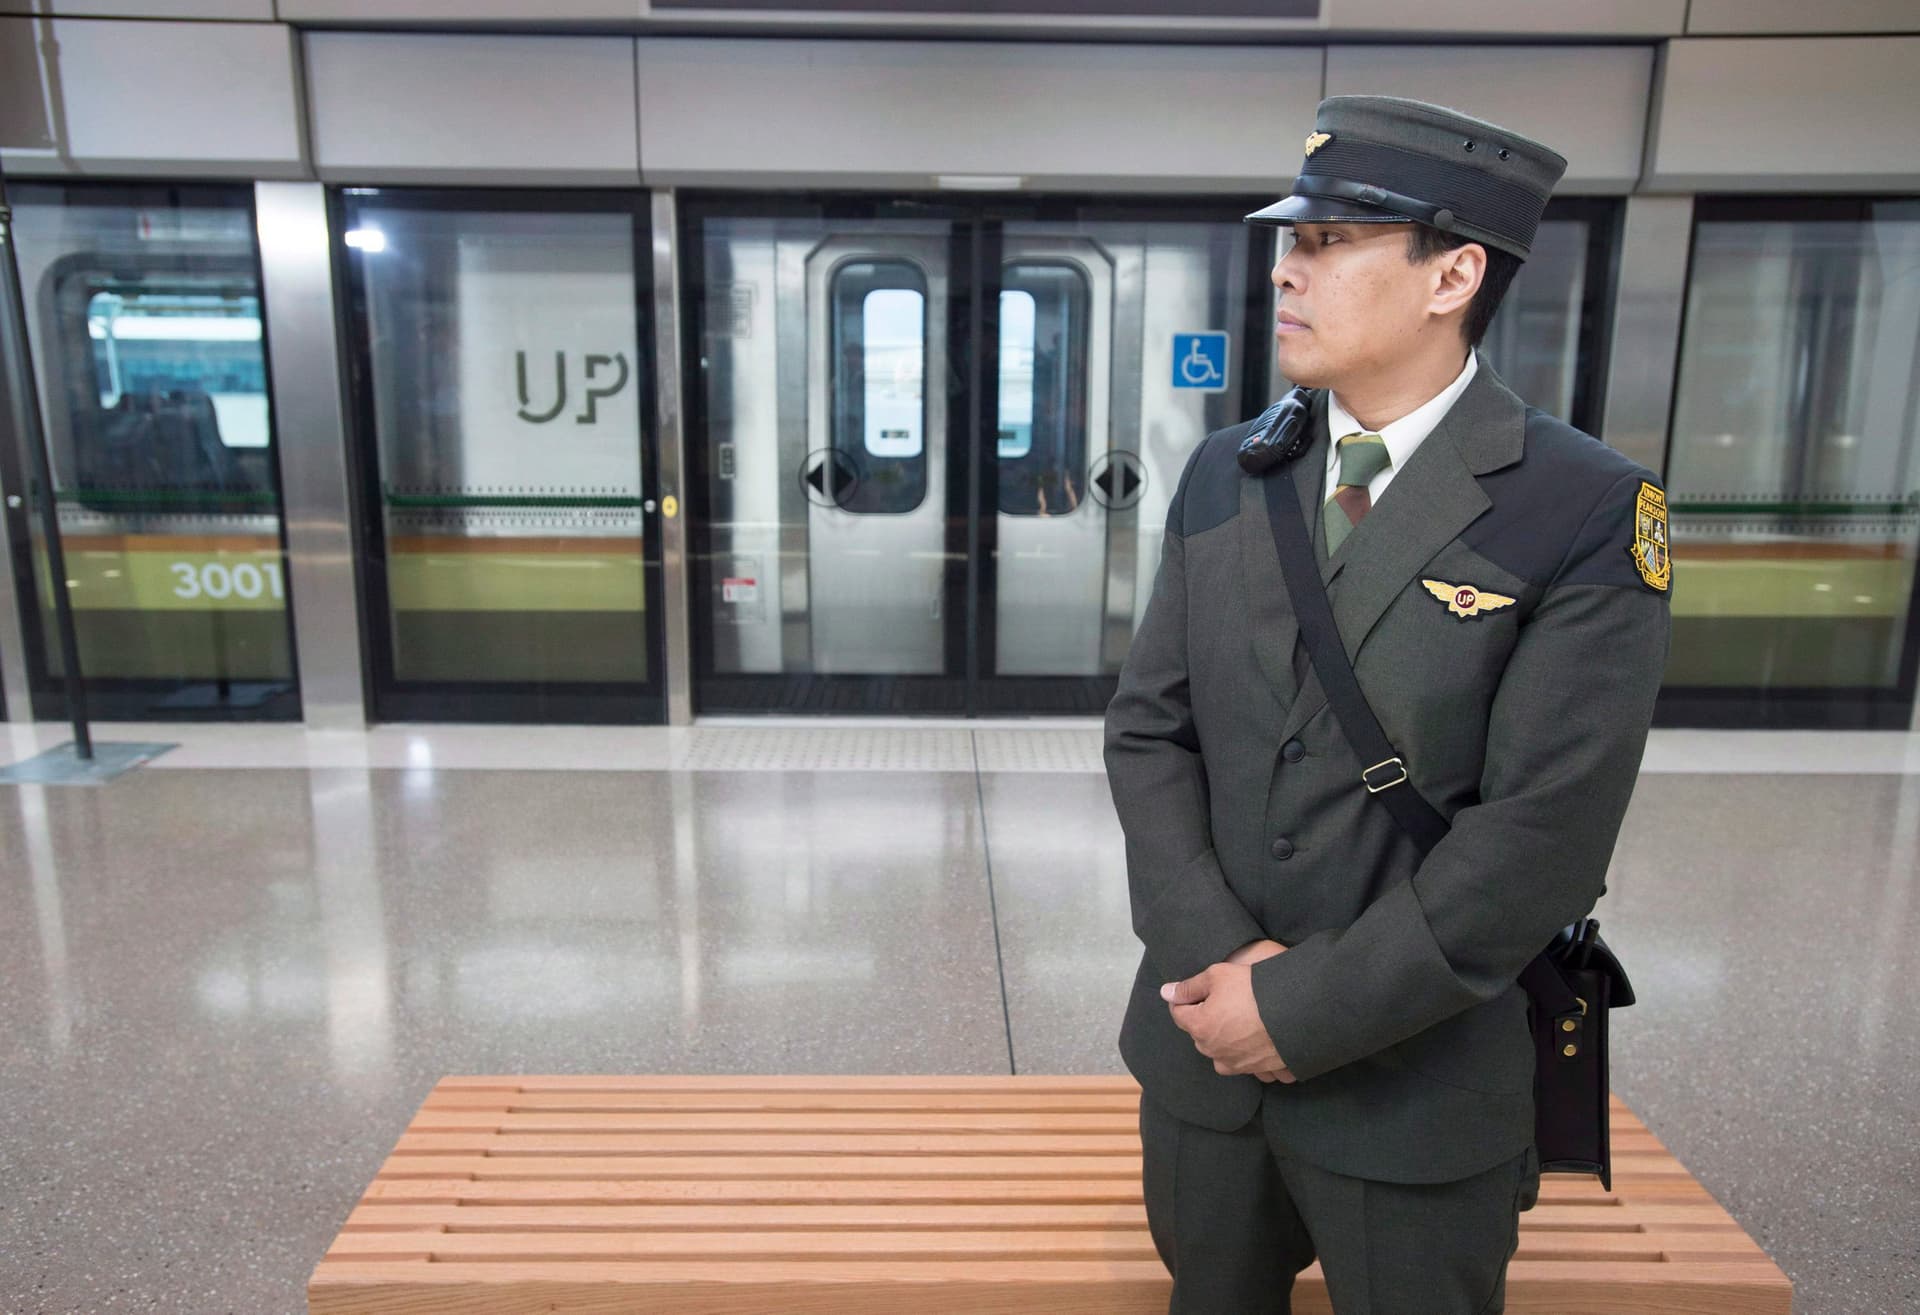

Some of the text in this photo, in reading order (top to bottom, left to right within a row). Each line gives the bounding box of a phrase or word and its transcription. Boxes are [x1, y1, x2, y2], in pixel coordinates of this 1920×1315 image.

[516, 351, 629, 424] UP
[1643, 487, 1663, 504] UNION
[1639, 498, 1665, 521] PEARSON
[171, 562, 284, 599] 3001
[1457, 592, 1475, 606] UP
